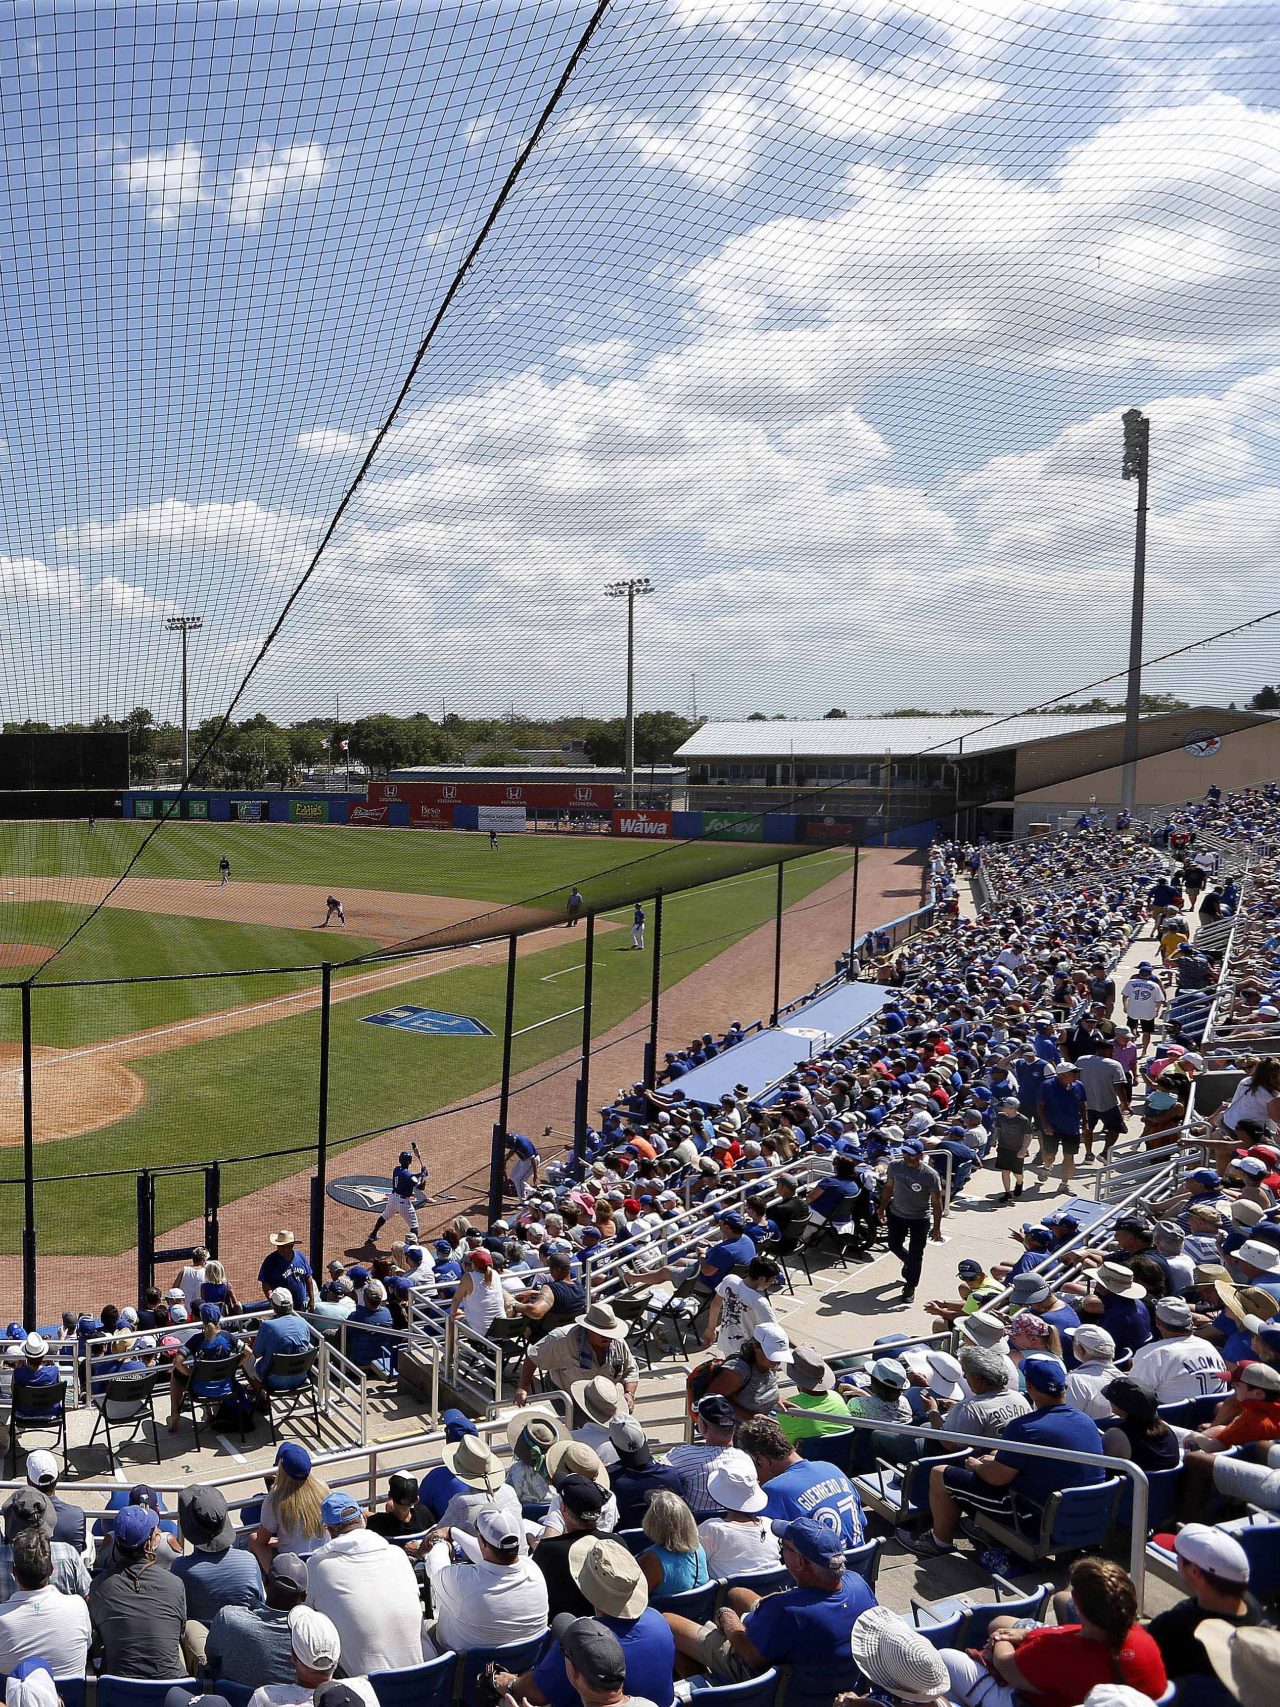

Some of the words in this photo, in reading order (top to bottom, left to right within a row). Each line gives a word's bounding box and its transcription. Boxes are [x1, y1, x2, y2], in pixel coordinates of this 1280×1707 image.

[619, 817, 668, 834] Wawa
[704, 817, 761, 834] Sobeys
[1133, 989, 1152, 1001] 19
[797, 1478, 841, 1512] GUERRERO
[812, 1494, 862, 1546] 27
